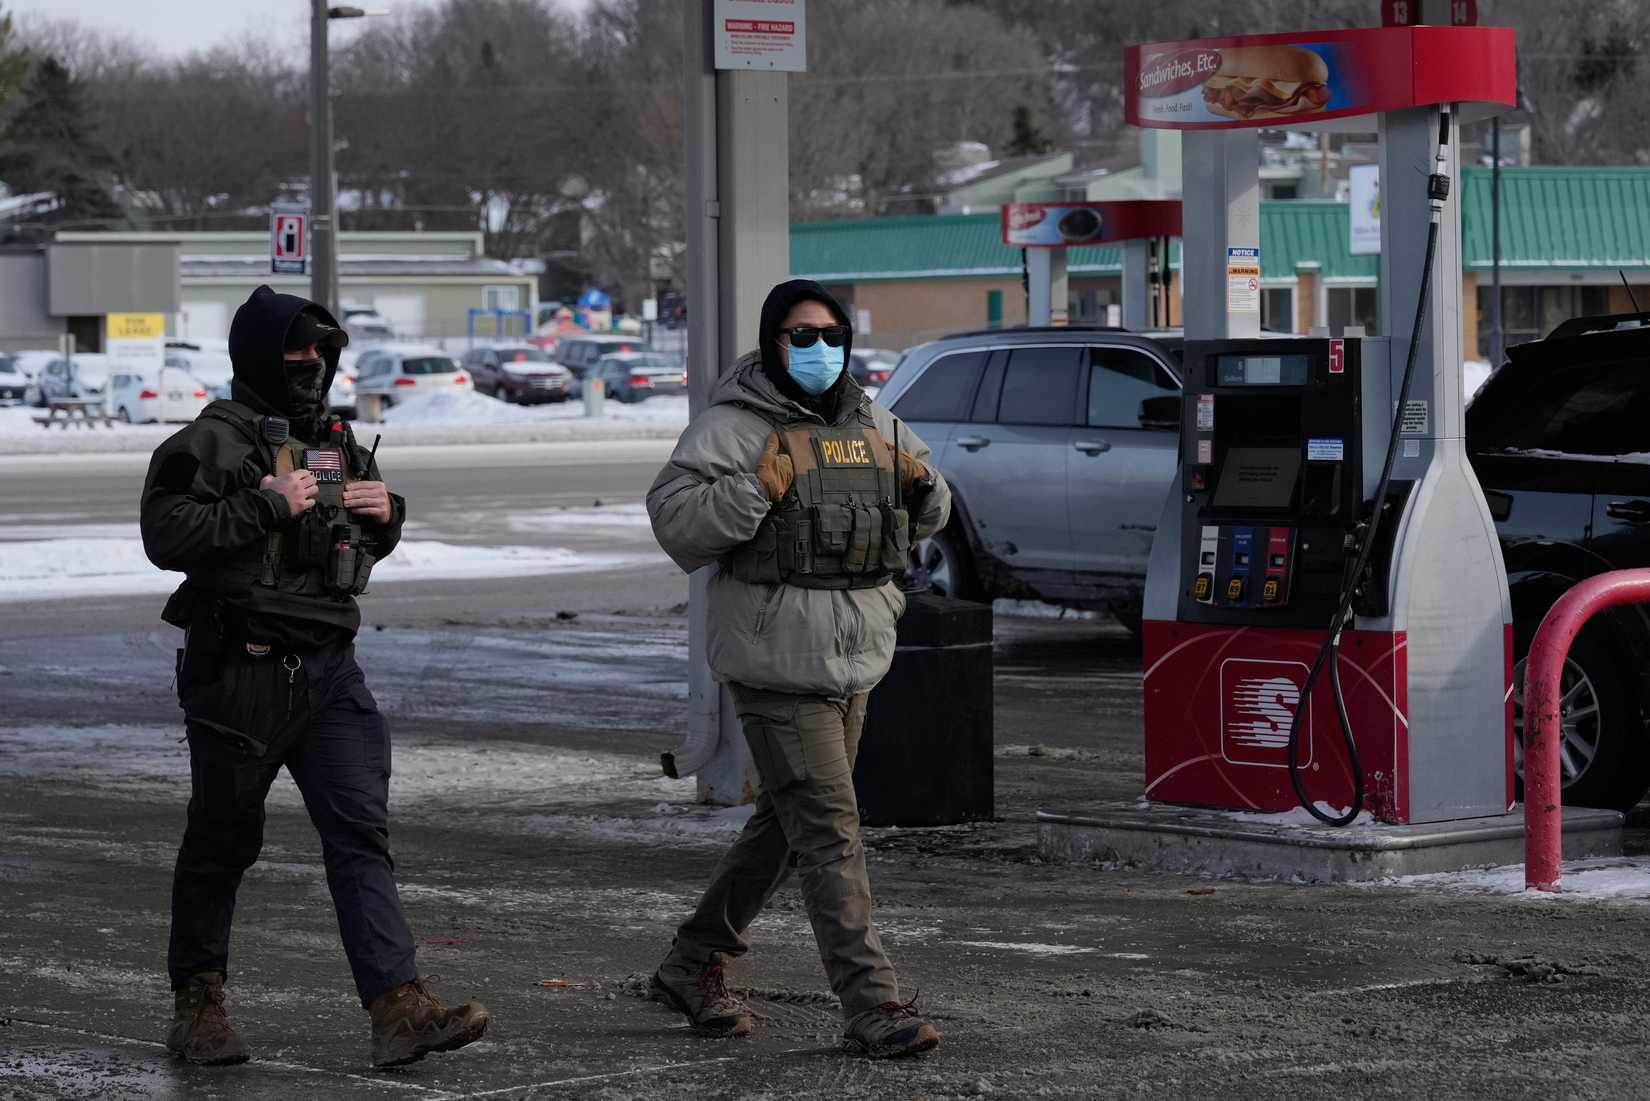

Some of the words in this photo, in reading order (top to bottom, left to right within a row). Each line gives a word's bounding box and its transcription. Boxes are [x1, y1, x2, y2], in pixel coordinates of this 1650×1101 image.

[1393, 1, 1408, 24] 13
[1139, 58, 1195, 90] Sandwiches,
[1197, 53, 1217, 73] Etc.
[1330, 341, 1343, 372] 5
[822, 440, 869, 463] POLICE
